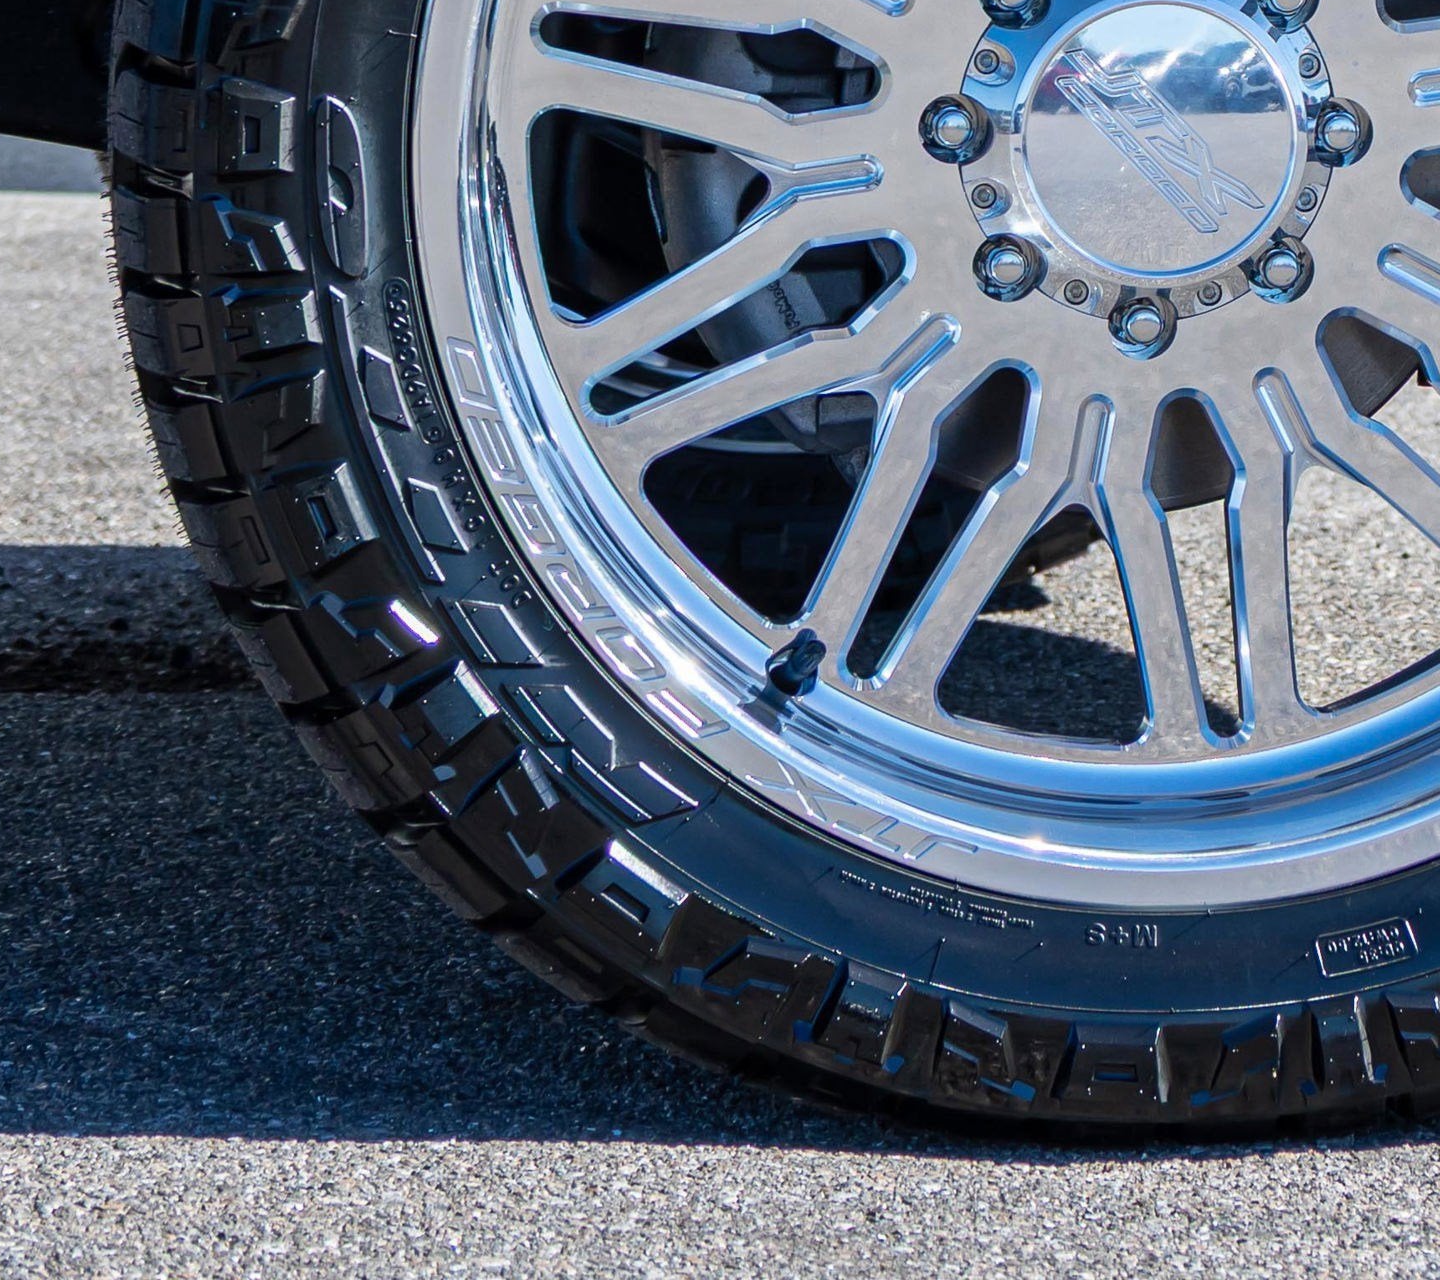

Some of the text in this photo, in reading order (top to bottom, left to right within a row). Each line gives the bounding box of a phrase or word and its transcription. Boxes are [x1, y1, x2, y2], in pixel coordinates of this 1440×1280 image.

[1055, 76, 1220, 233] FORGED
[1063, 48, 1265, 216] JTX
[318, 95, 699, 822] NITTO
[445, 336, 980, 858] JTX FORGED
[486, 556, 533, 609] DOT
[1083, 918, 1160, 948] M+S
